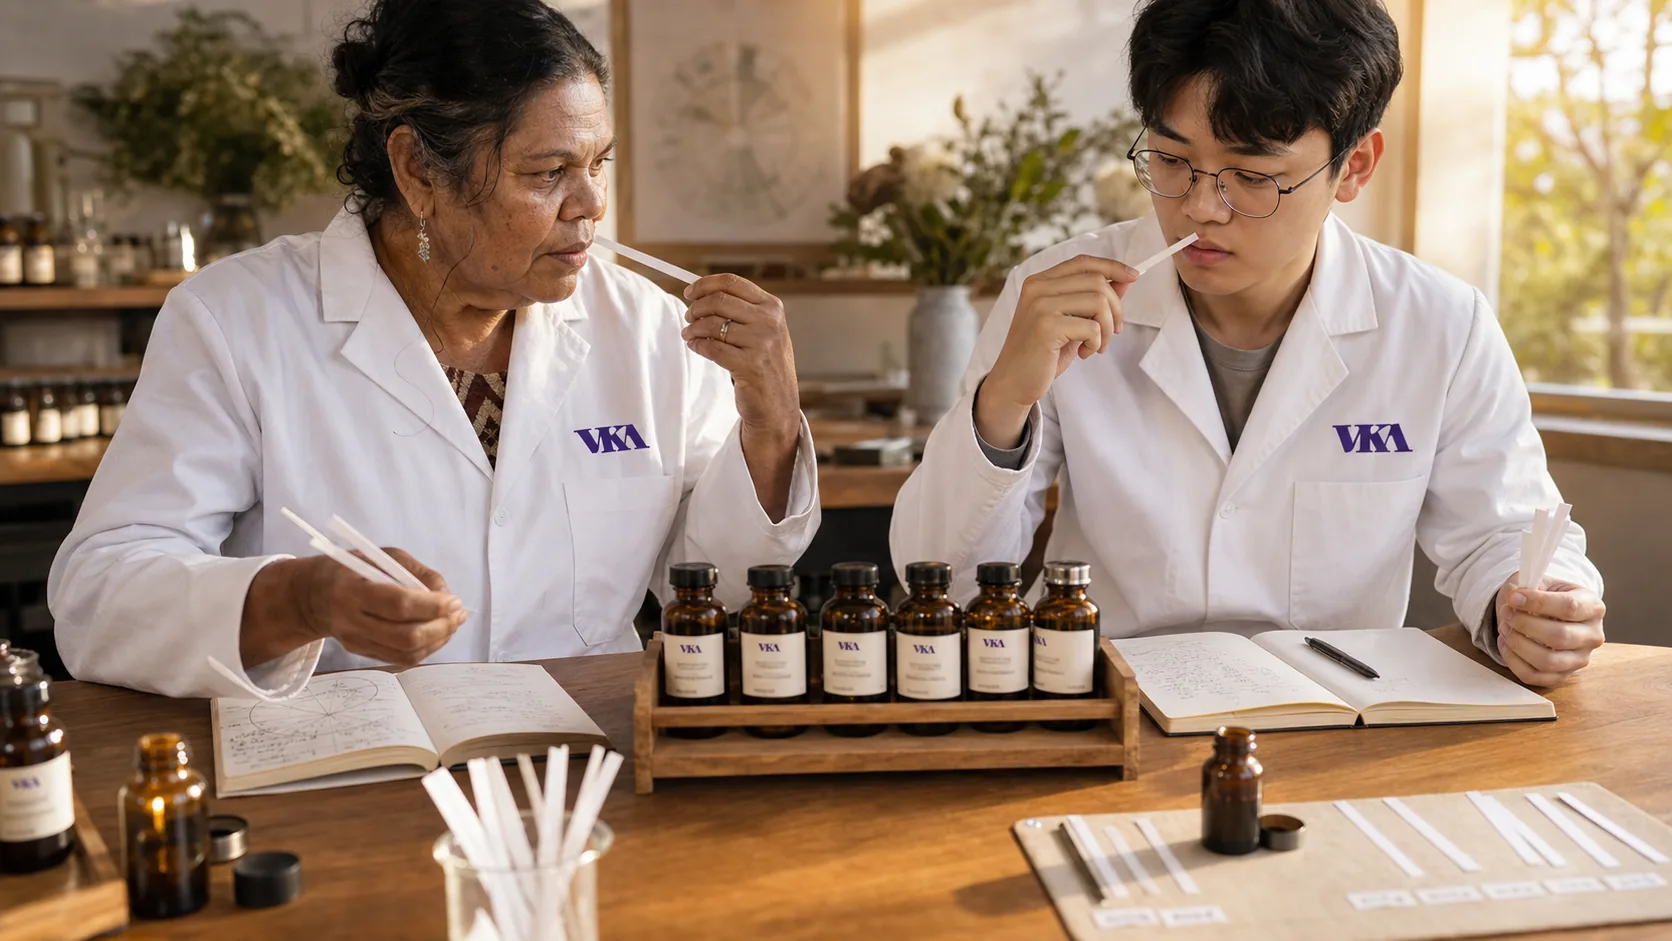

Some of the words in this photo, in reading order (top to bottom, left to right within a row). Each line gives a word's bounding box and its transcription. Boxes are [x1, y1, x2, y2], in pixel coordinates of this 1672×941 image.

[574, 424, 649, 454] VKA
[1333, 423, 1414, 453] VKA
[680, 644, 702, 654] VKA
[759, 643, 781, 653] VKA
[837, 642, 862, 652] VKA
[983, 639, 1006, 649] VKA
[913, 644, 936, 655] VKA
